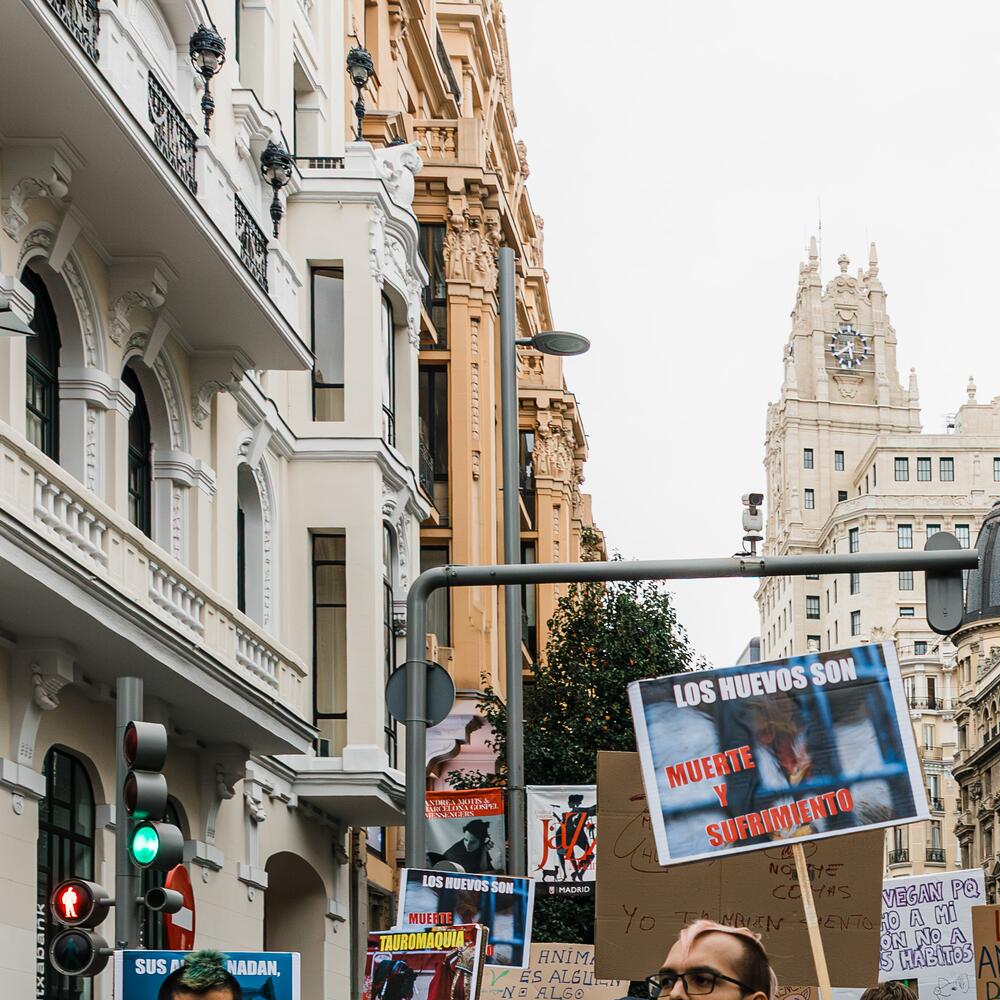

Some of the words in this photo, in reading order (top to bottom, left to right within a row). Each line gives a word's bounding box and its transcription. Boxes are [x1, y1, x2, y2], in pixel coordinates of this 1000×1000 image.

[673, 681, 717, 708] LOS
[719, 665, 810, 702] HUEVOS
[811, 658, 857, 687] SON
[665, 745, 756, 788] MUERTE
[713, 783, 729, 807] Y
[705, 788, 855, 847] SUFRIMIENTO
[422, 874, 444, 888] LOS
[445, 877, 490, 892] HUEVOS
[490, 880, 515, 894] SON
[559, 885, 590, 893] MADRID
[882, 881, 944, 908] VEGAN
[951, 878, 981, 900] PQ
[408, 911, 453, 925] MUERTE
[622, 903, 656, 934] YO
[909, 909, 925, 927] A
[379, 930, 466, 952] TAUROMAQUIA
[915, 927, 942, 947] NO
[950, 927, 967, 944] A
[135, 959, 167, 975] SUS
[227, 960, 281, 977] NADAN,
[520, 969, 542, 984] ES
[502, 985, 528, 999] NO
[535, 986, 585, 1000] ALGO
